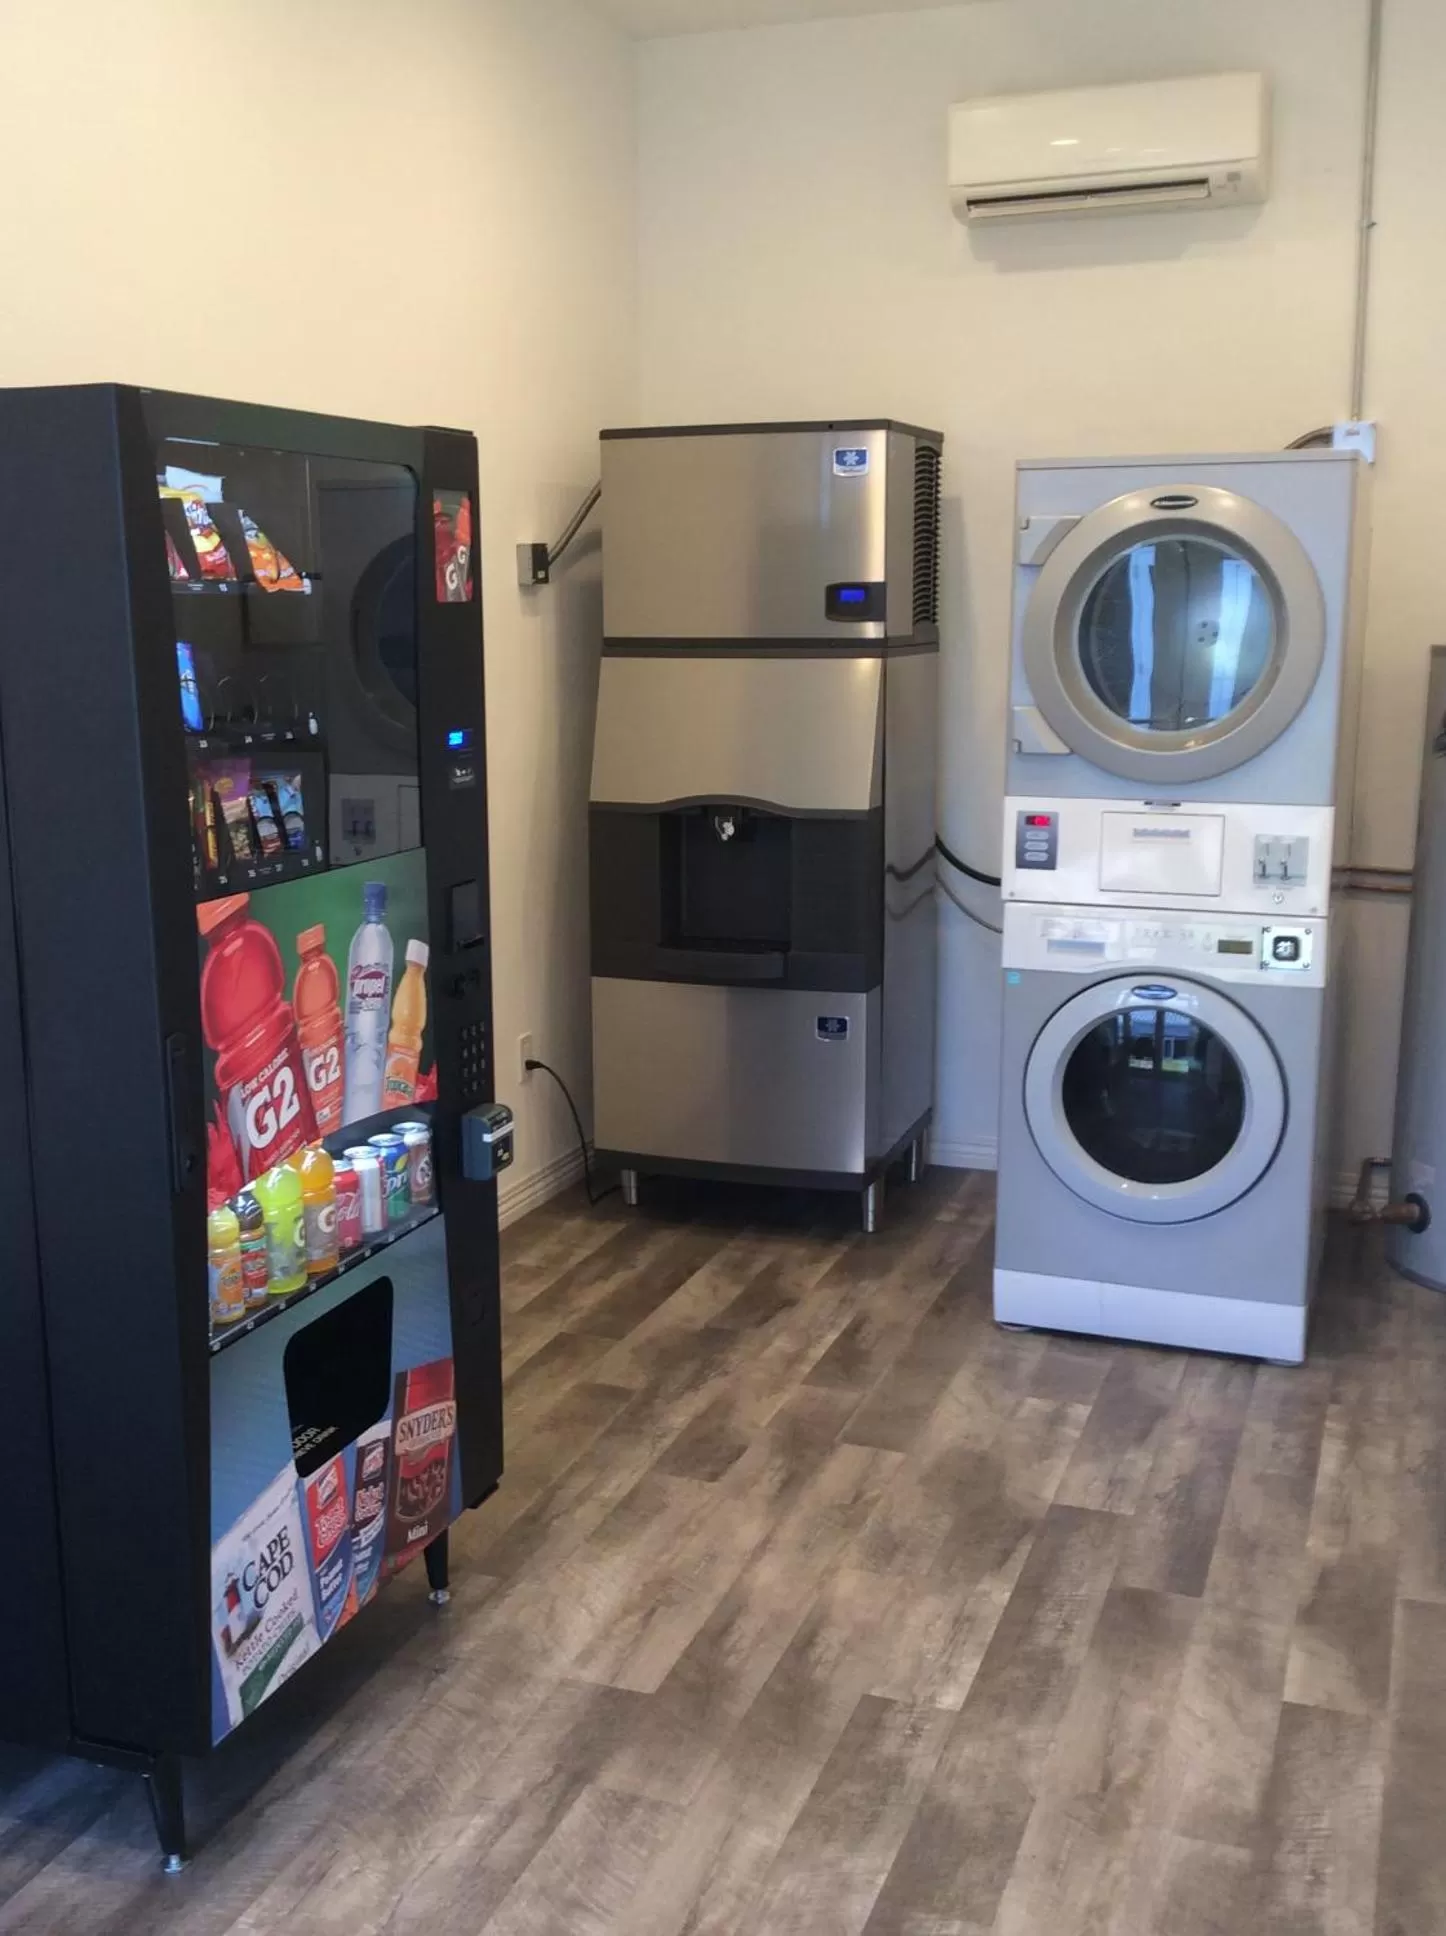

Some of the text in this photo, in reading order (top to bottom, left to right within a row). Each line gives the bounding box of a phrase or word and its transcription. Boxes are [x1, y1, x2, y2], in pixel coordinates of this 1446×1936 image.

[446, 563, 458, 590] G
[457, 545, 466, 564] G
[310, 1046, 341, 1091] G2
[246, 1066, 300, 1149] G2
[399, 1406, 454, 1443] SNYDER'S
[242, 1526, 291, 1592] CAPE
[253, 1551, 294, 1609] COD
